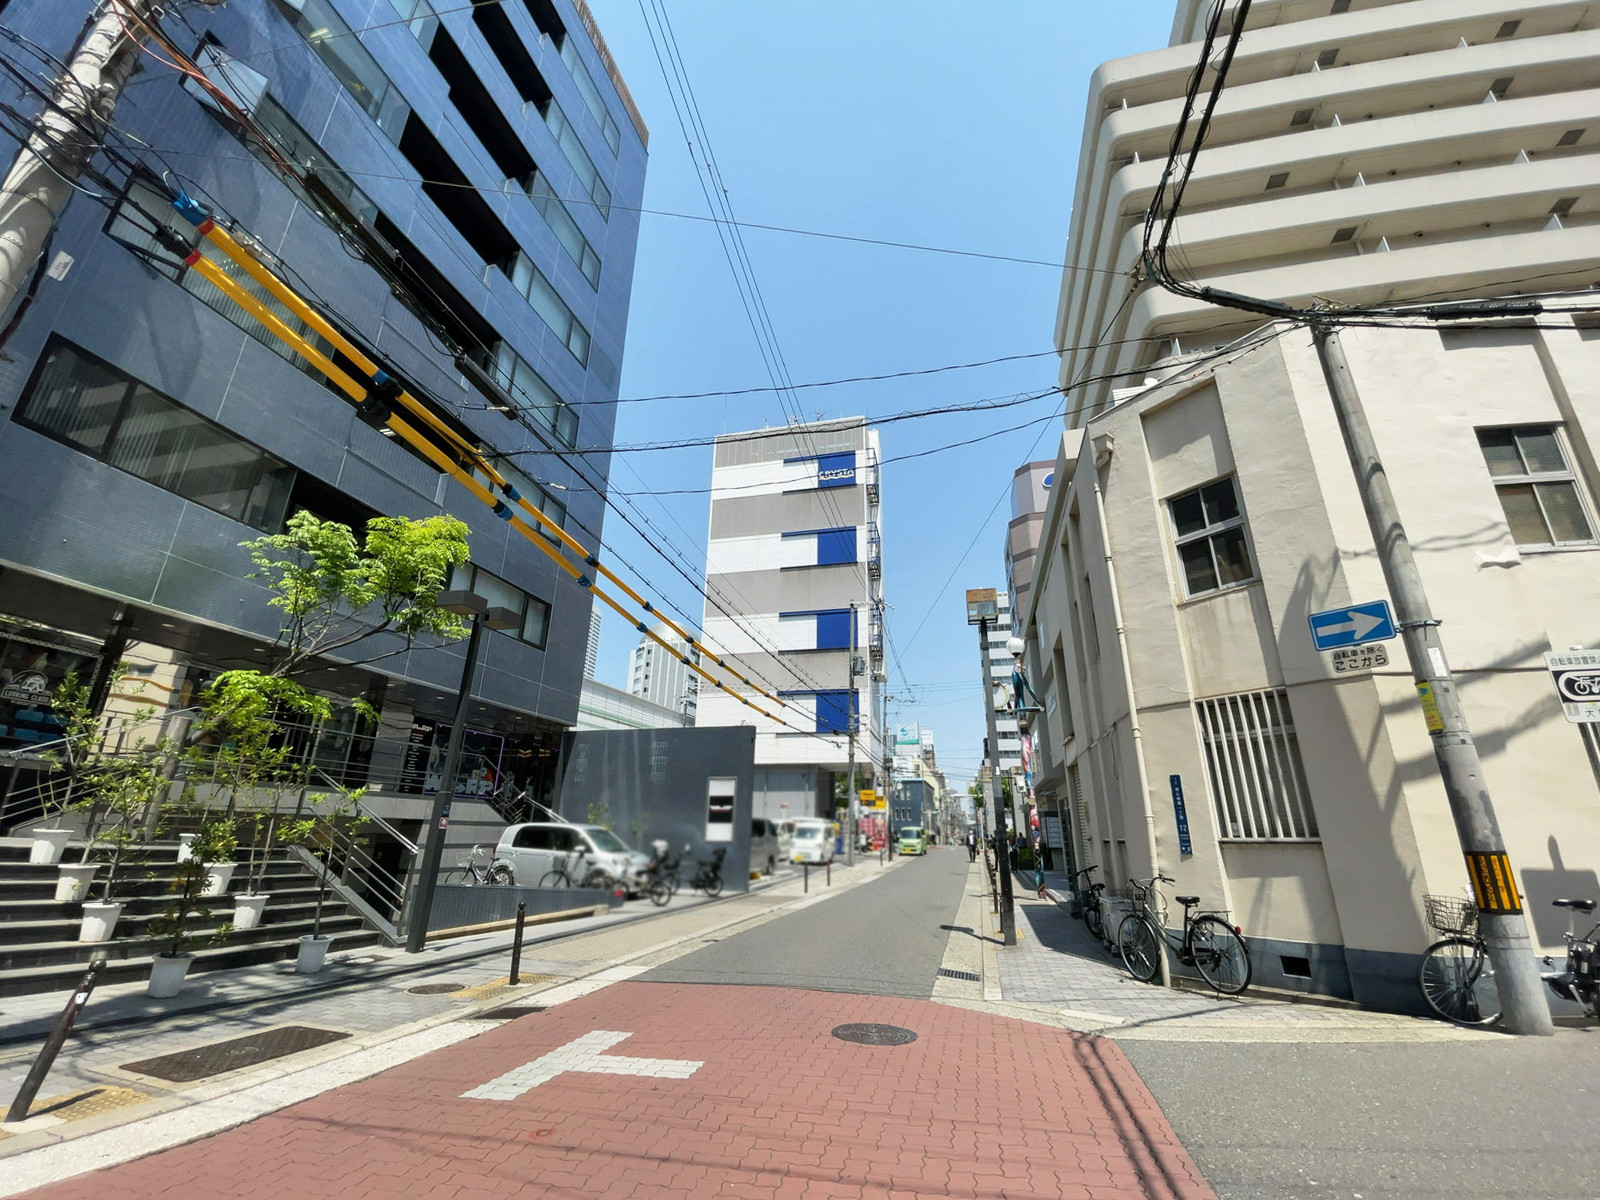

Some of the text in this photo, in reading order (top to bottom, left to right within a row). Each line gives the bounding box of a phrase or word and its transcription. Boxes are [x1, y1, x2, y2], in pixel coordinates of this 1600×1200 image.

[818, 468, 855, 477] CRYSTA
[1333, 646, 1383, 660] 自転車を除く
[1336, 655, 1387, 670] ここから
[1550, 656, 1600, 666] 自転車放置禁
[1179, 824, 1188, 832] 12
